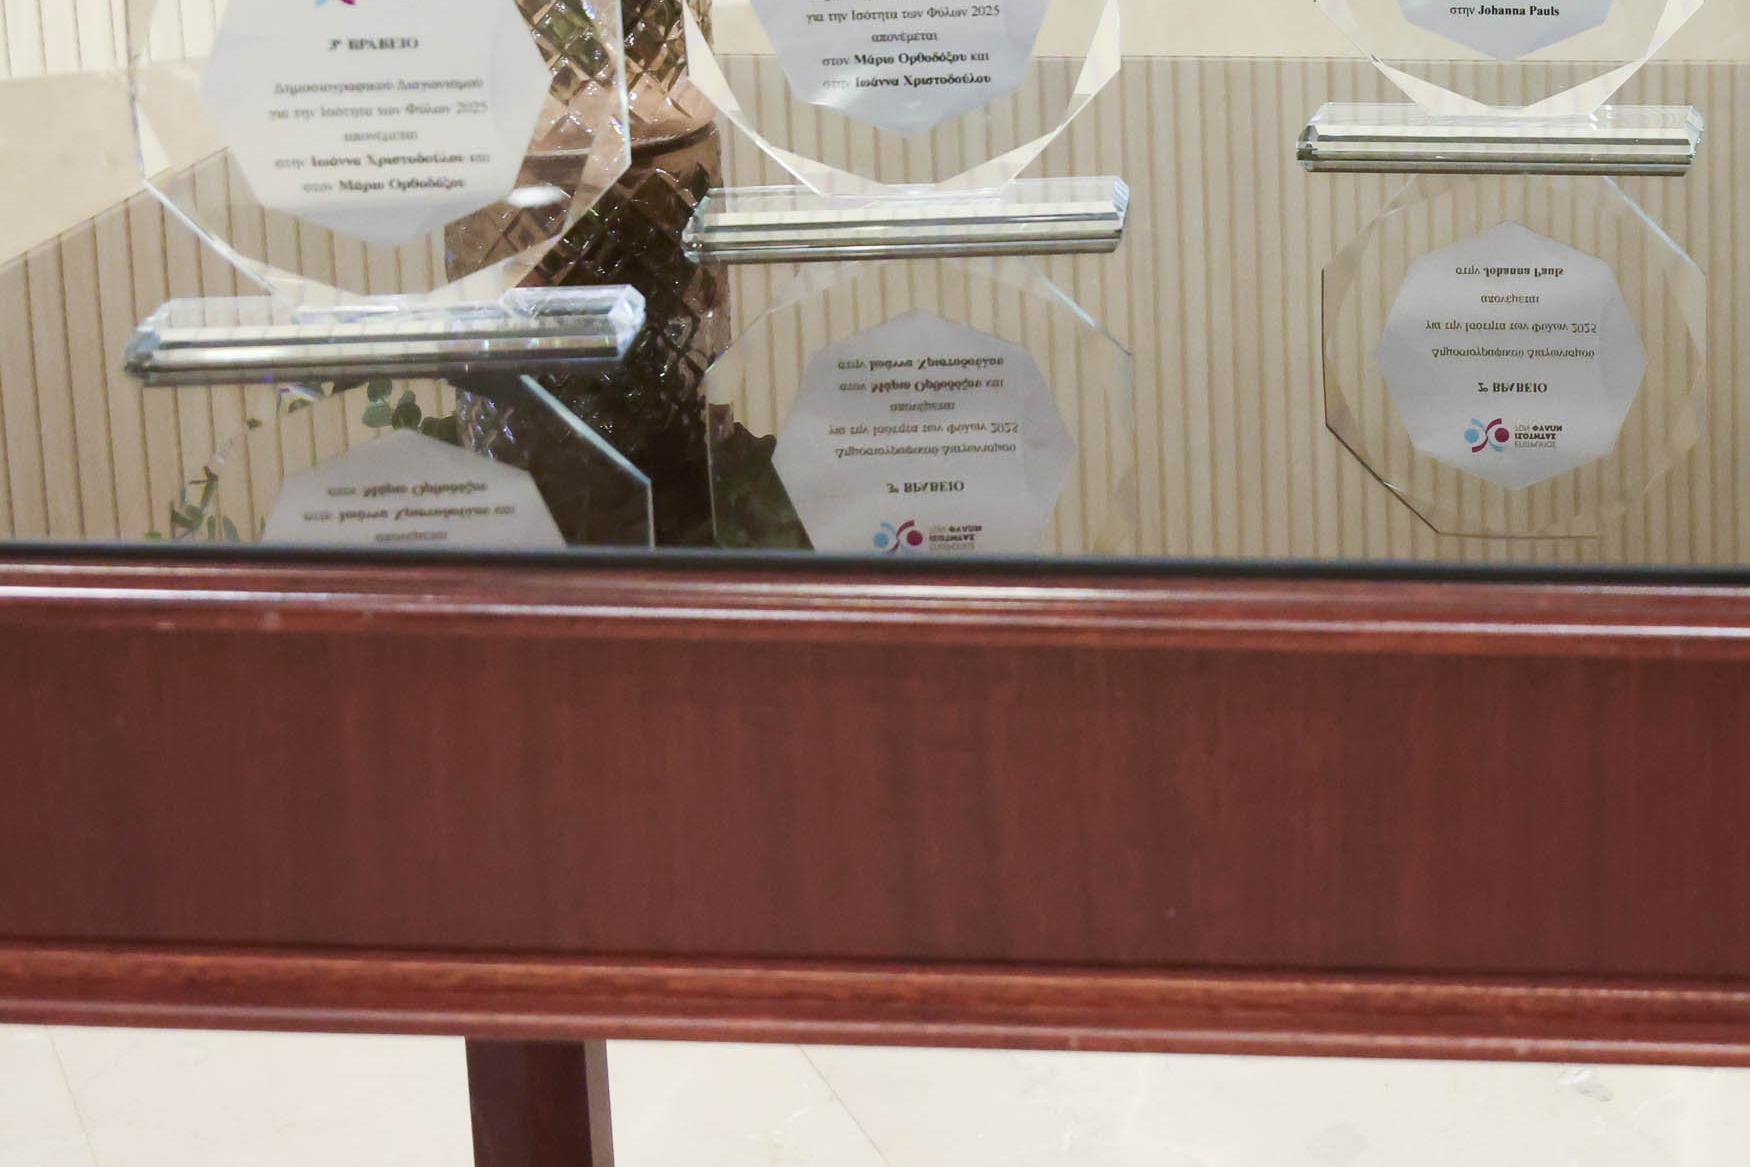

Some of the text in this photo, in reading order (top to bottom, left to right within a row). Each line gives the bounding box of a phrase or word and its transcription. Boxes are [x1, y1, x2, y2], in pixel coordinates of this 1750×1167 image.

[805, 4, 1000, 25] για την Ισότητα των Φύλων 2025
[1449, 4, 1560, 18] στην Johanna Pauls
[871, 31, 938, 45] απονέμεται
[821, 51, 990, 67] στον Μάριο Ορθοδόξου και
[855, 74, 900, 88] Ιωάννα
[903, 72, 992, 88] Χριστοδούλου
